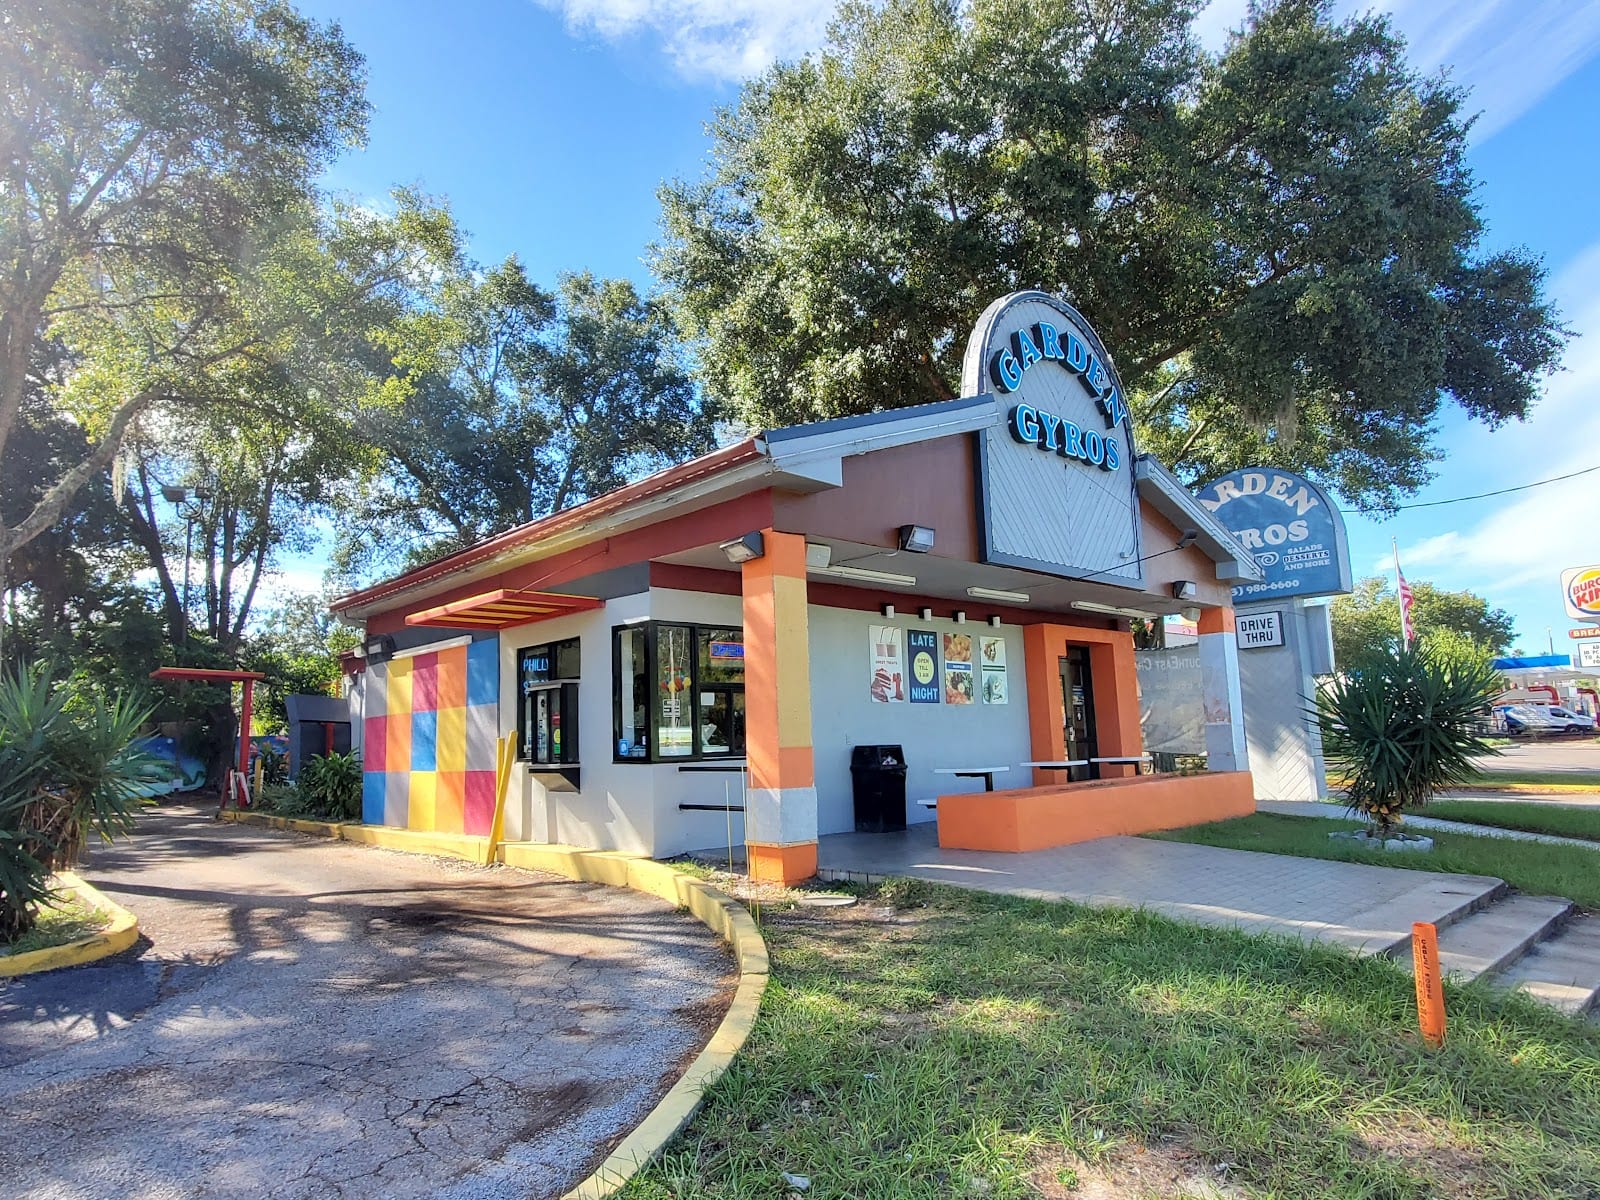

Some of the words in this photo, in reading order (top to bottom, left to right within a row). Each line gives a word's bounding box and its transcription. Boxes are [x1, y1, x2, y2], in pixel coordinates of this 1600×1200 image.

[998, 320, 1127, 429] GARDEN
[1015, 403, 1121, 472] GYROS
[1287, 543, 1323, 555] SALADS
[1283, 550, 1330, 563] DESSERTS
[1284, 562, 1304, 572] AND
[1304, 559, 1331, 568] MORE
[1245, 578, 1300, 595] 980-6600
[1576, 587, 1600, 608] KIN
[1241, 617, 1274, 632] DRIVE
[1245, 631, 1274, 644] THRU
[1573, 628, 1600, 637] BREA
[911, 634, 935, 647] LATE
[911, 687, 939, 701] NIGHT
